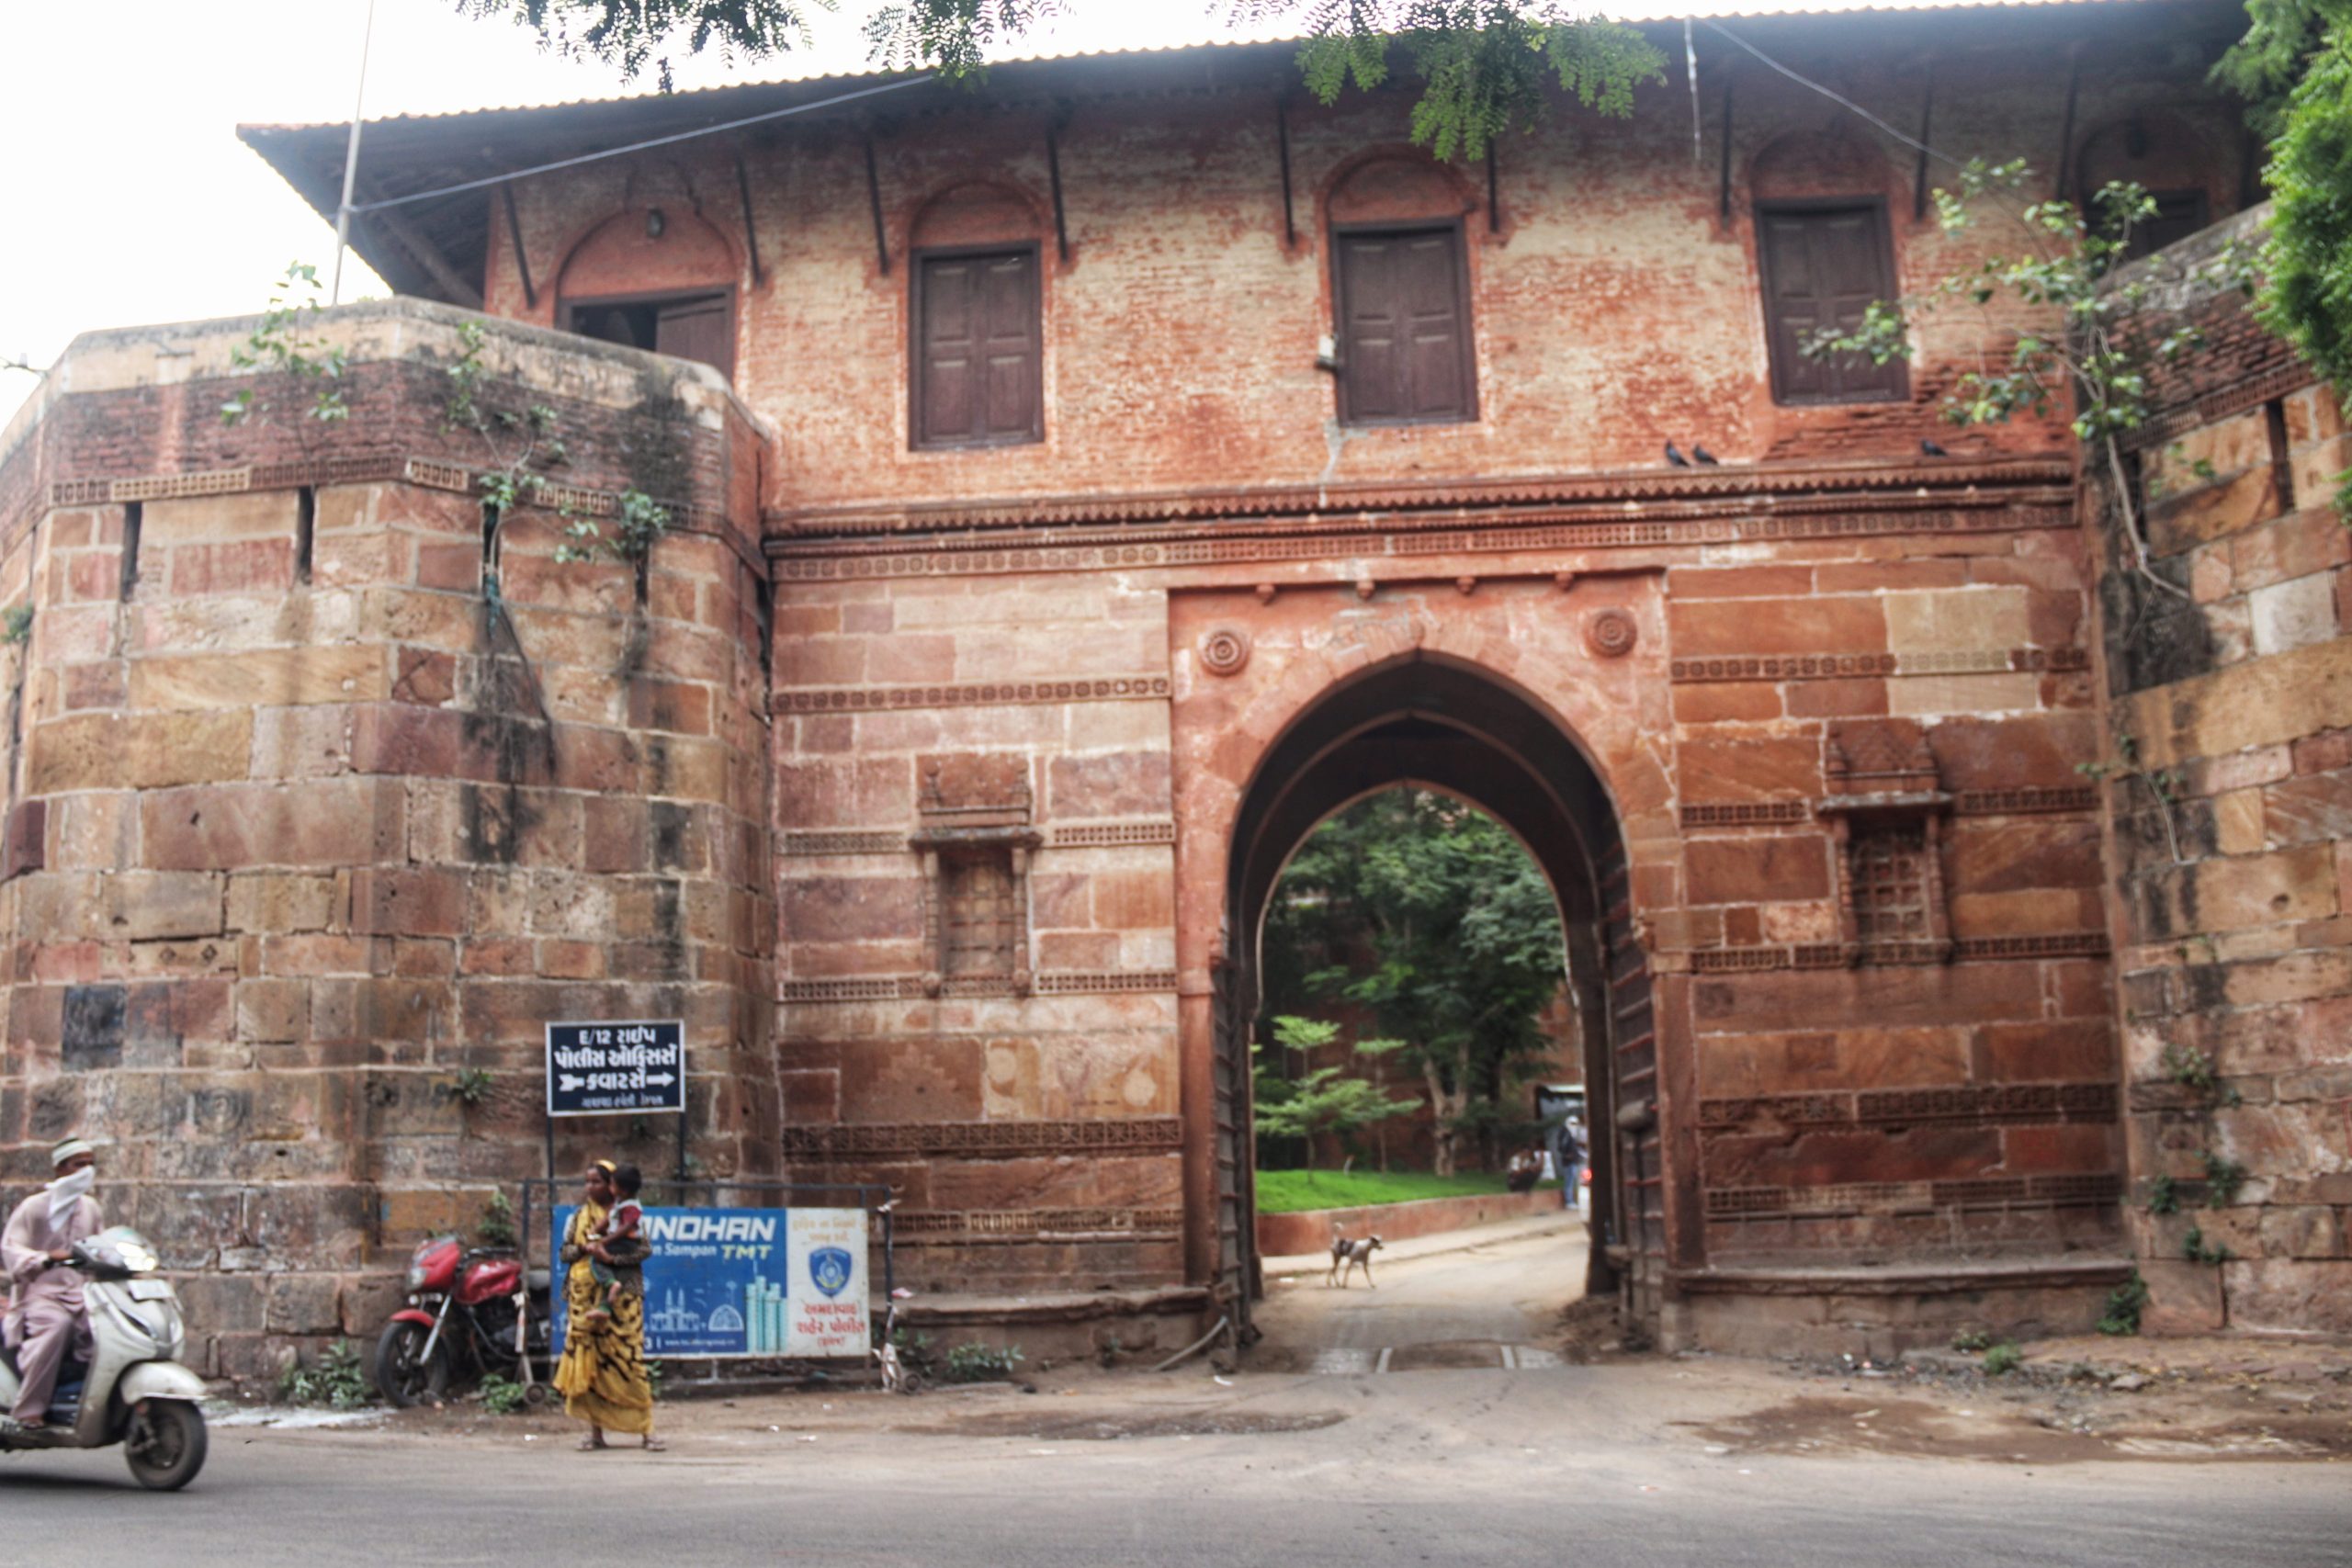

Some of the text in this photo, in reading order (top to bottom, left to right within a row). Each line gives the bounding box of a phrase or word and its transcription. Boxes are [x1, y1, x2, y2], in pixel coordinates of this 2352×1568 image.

[579, 1029, 611, 1045] E/12
[554, 1045, 605, 1068] પોલીસ
[664, 1243, 717, 1258] Sampan
[721, 1245, 773, 1259] TMT
